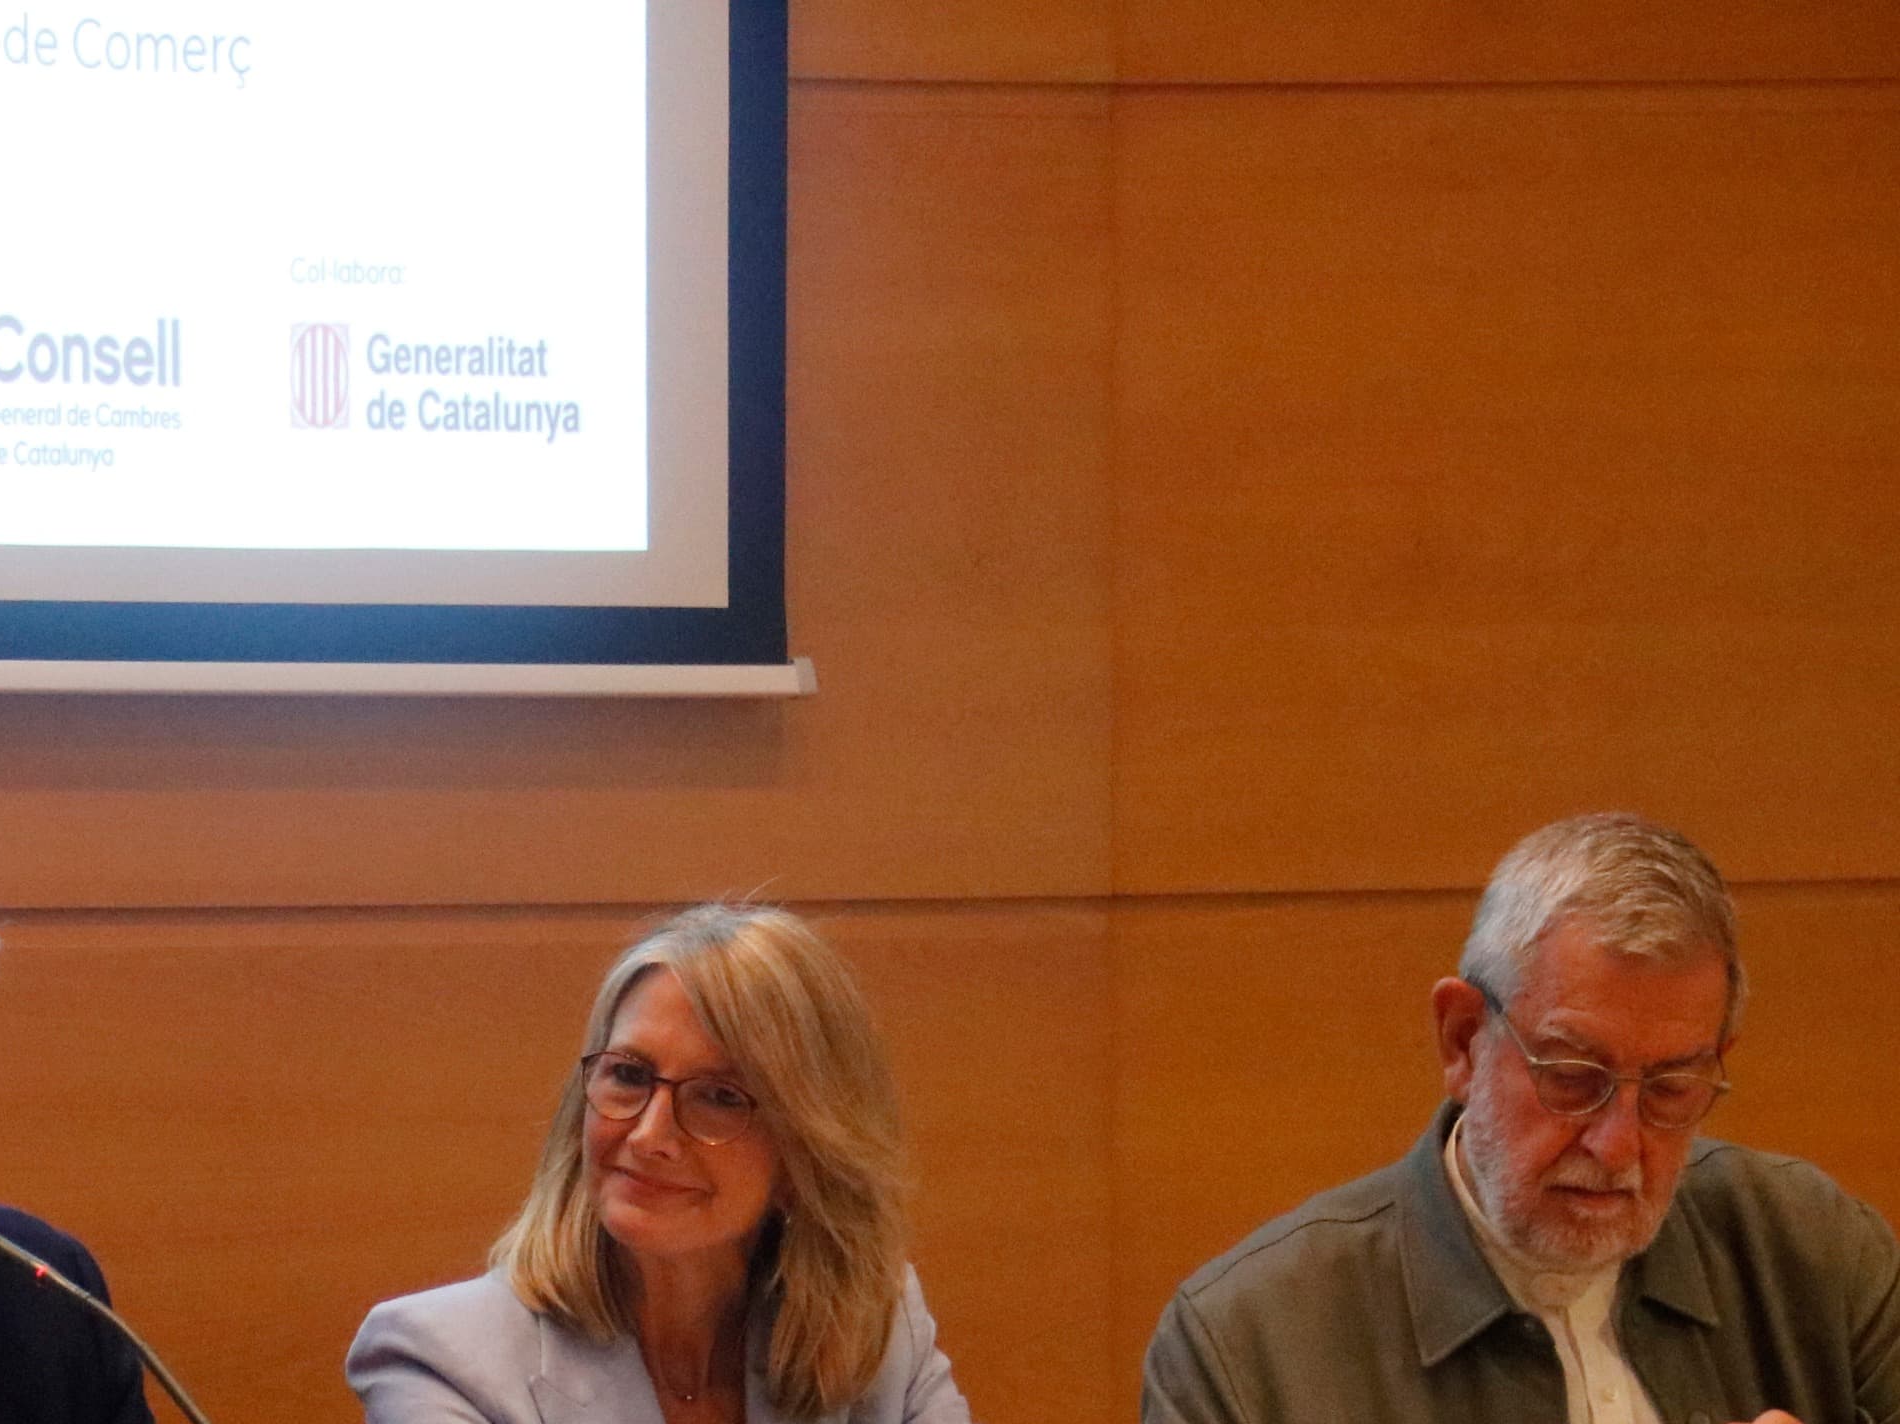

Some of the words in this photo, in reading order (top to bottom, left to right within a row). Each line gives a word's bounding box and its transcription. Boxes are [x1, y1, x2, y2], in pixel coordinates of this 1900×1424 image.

[3, 12, 58, 66] de
[72, 16, 253, 90] Comerç
[366, 332, 550, 378] Generalitat
[67, 402, 92, 427] de
[95, 402, 183, 431] Cambres
[366, 387, 407, 431] de
[417, 388, 582, 444] Catalunya
[13, 440, 116, 473] Catalunya
